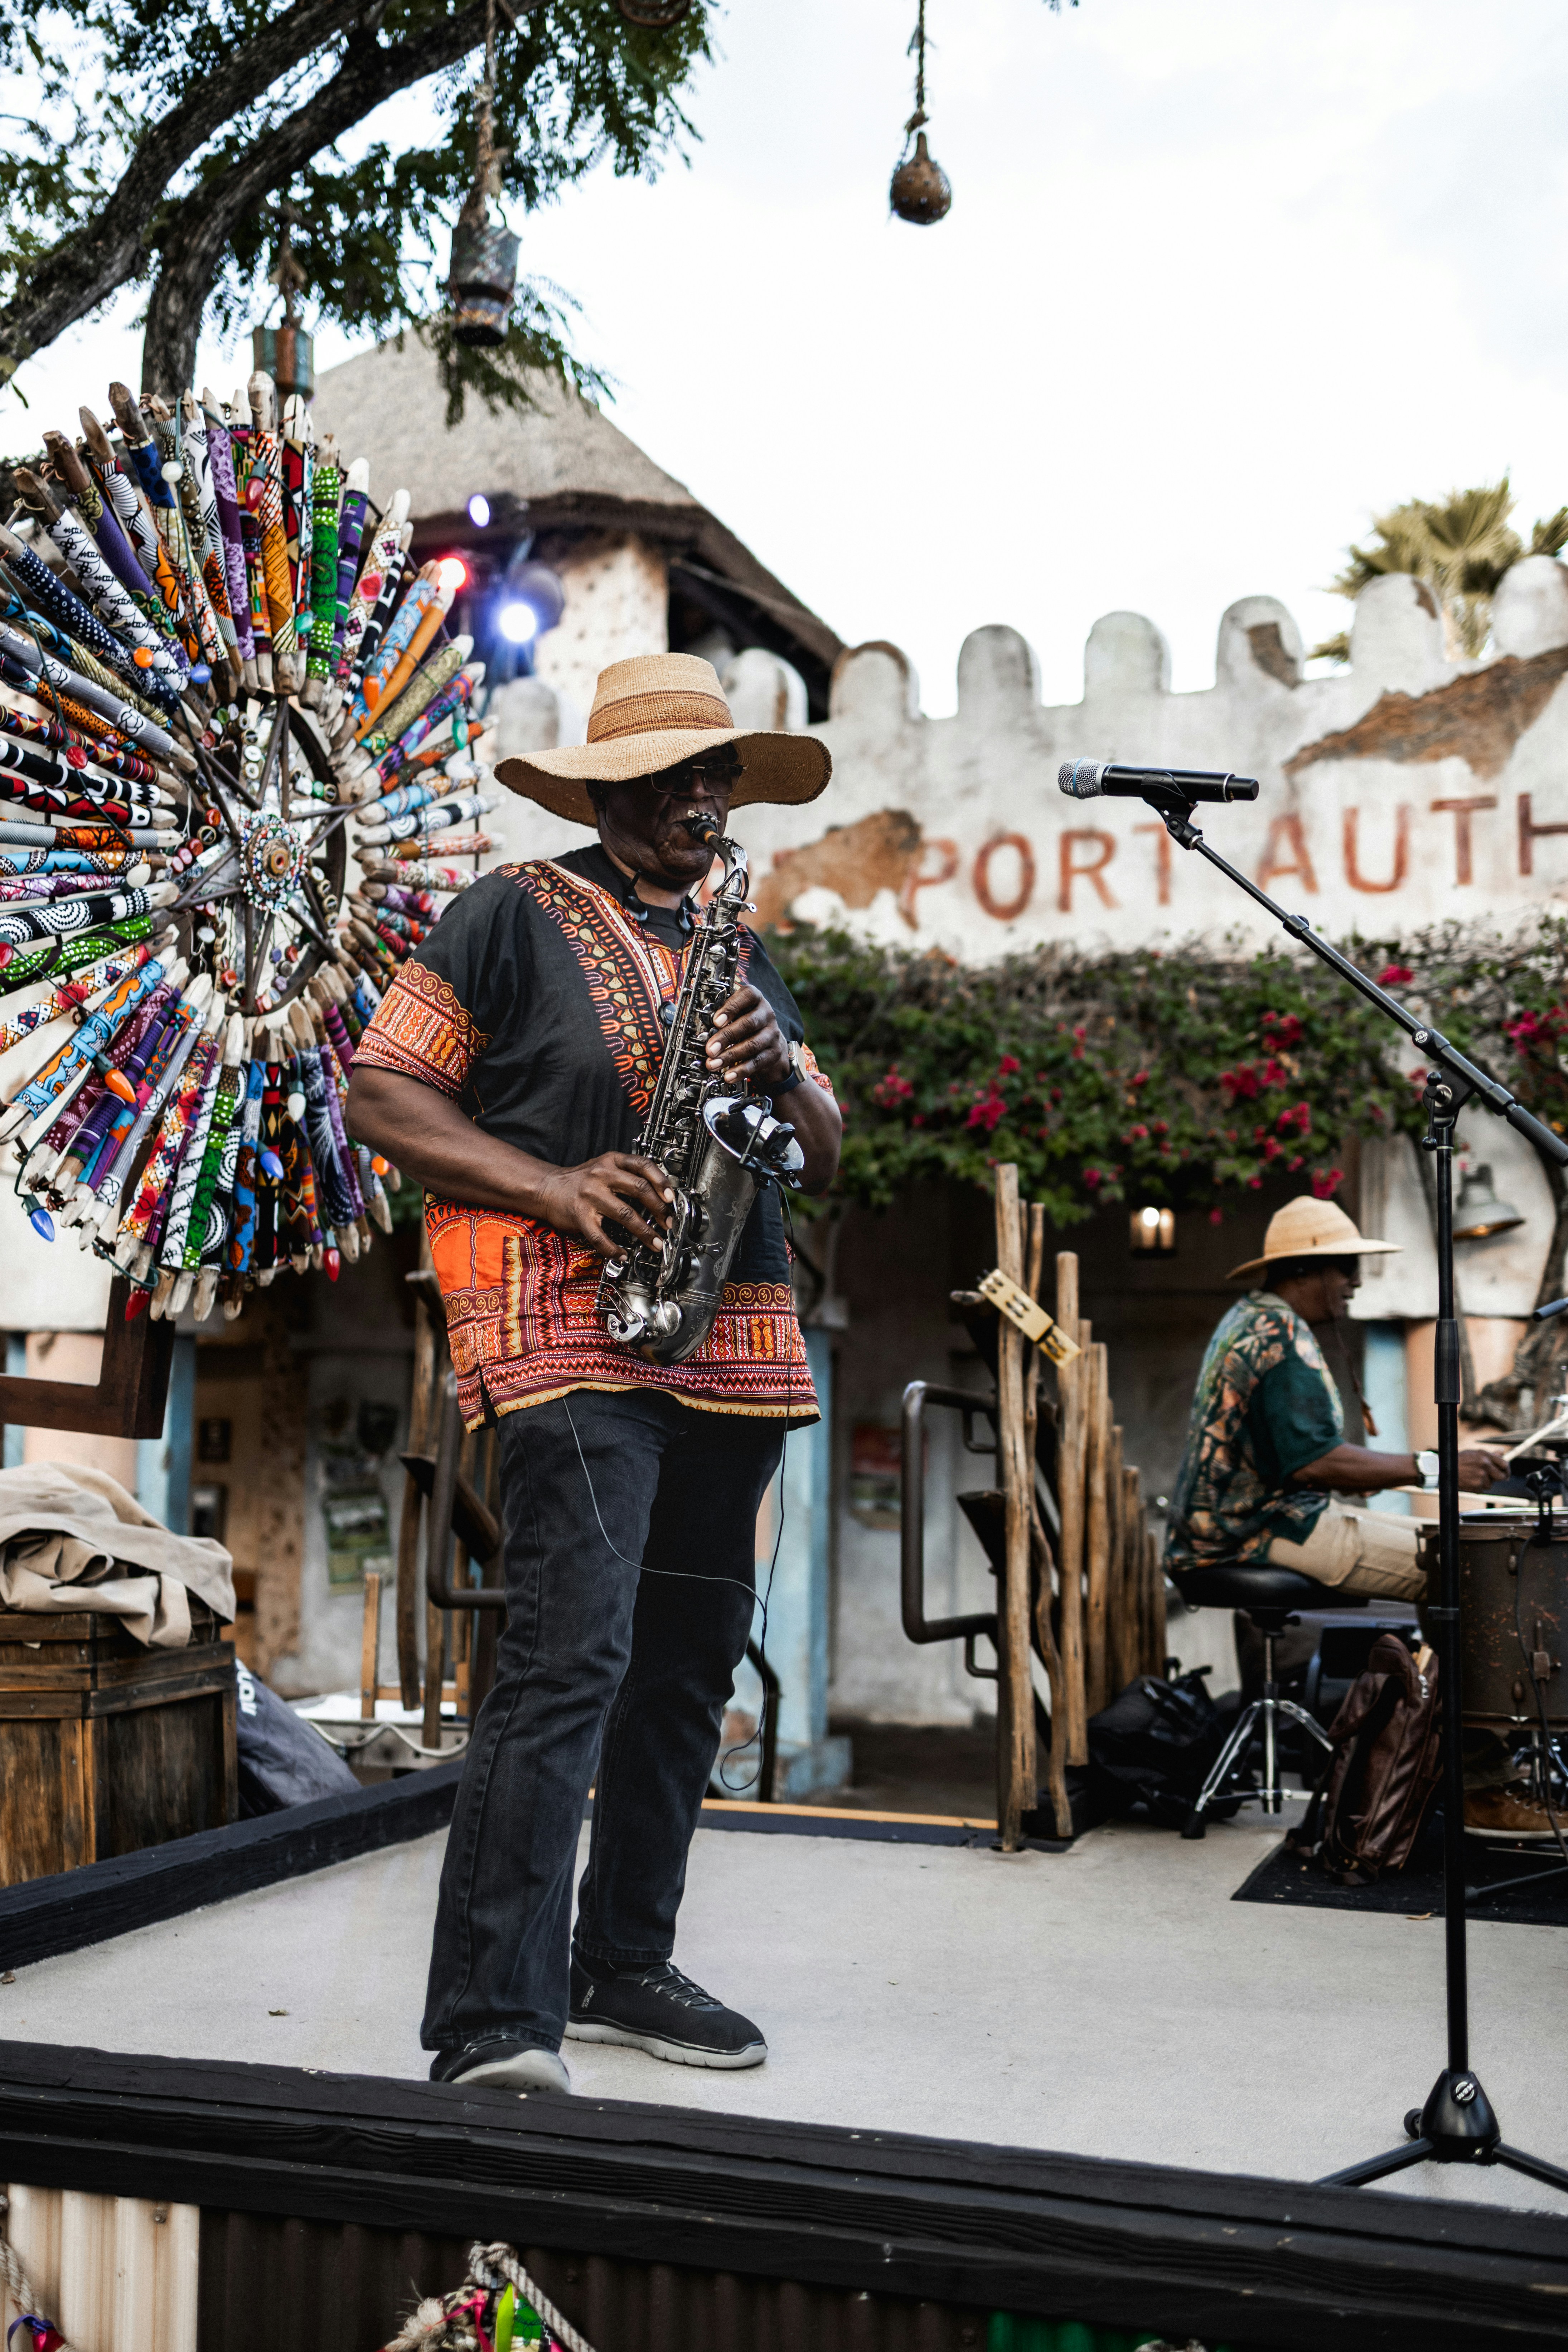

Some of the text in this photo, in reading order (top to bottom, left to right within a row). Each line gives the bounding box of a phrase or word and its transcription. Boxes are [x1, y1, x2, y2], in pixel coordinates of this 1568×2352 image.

[897, 821, 1197, 930] PORT
[1415, 1032, 1428, 1042] K&M
[581, 1985, 594, 2008] SKECHERS
[1456, 2083, 1474, 2100] K&M
